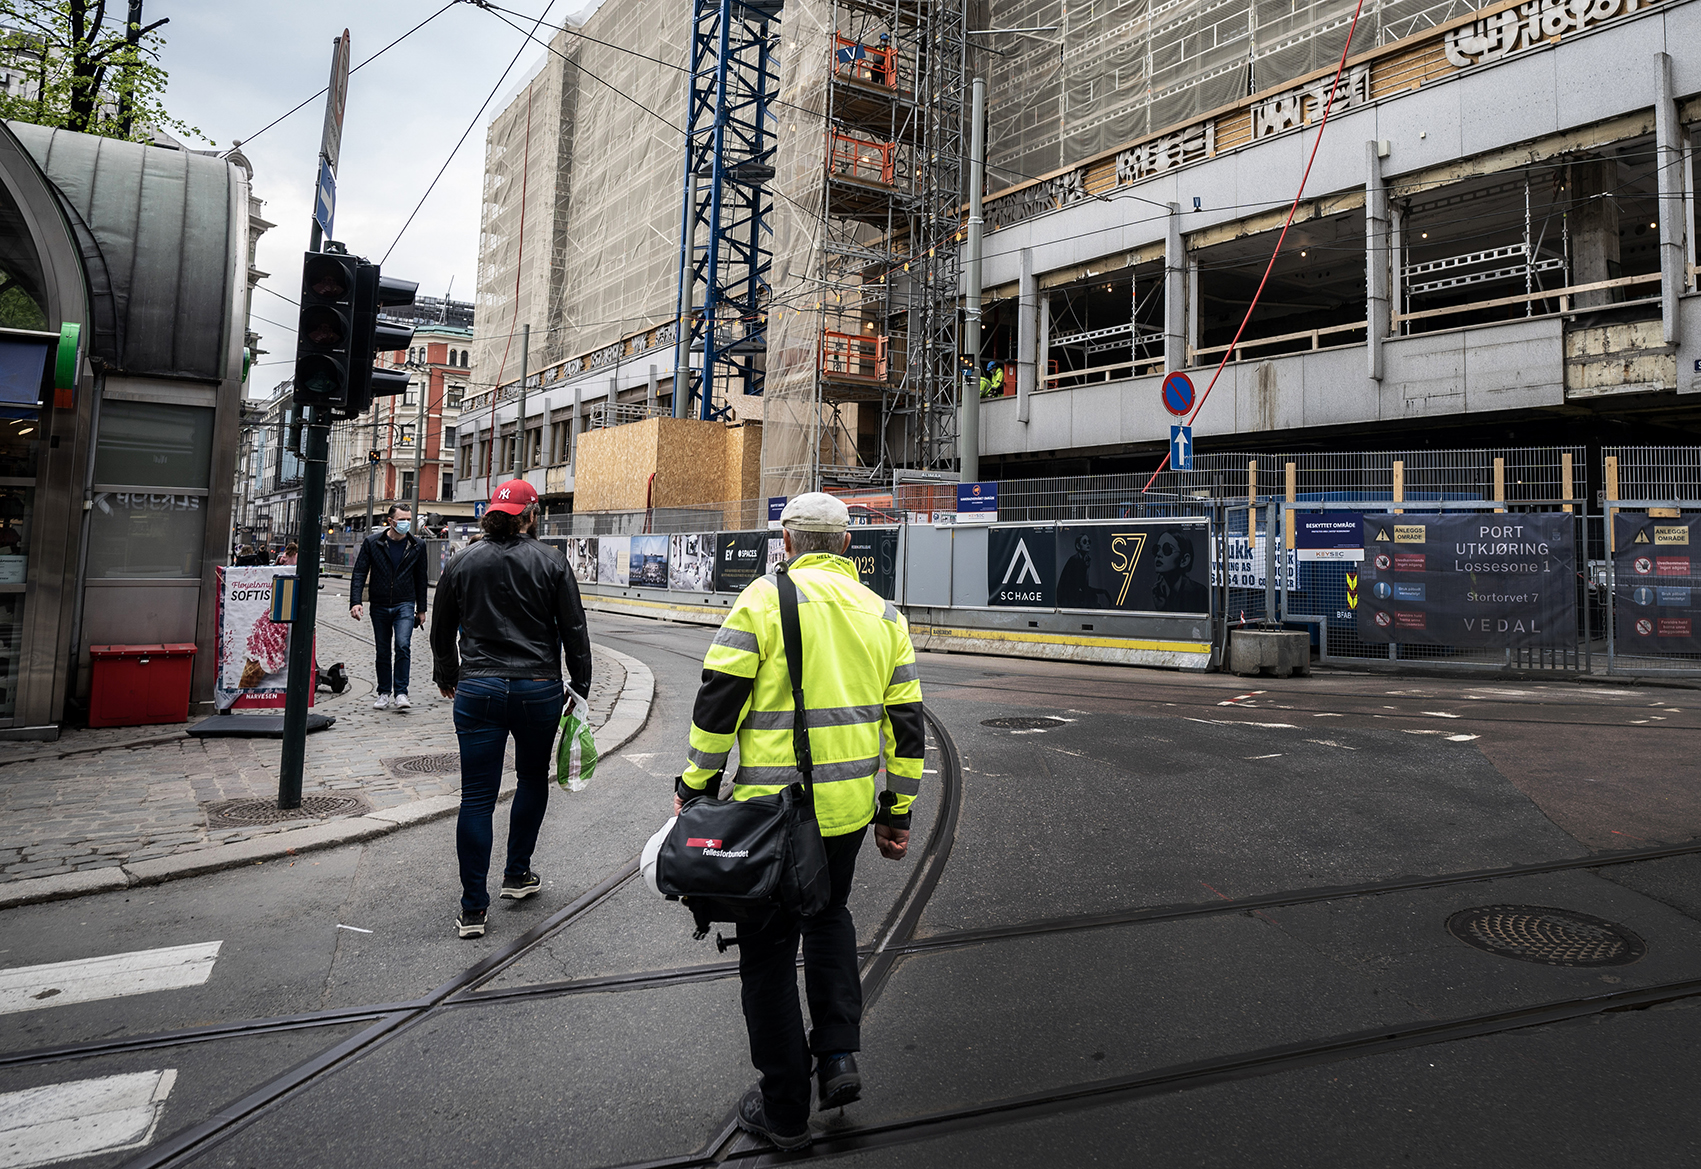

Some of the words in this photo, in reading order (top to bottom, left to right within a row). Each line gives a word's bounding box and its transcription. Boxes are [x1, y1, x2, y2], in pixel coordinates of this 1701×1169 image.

[1480, 526, 1524, 538] PORT
[1456, 543, 1549, 555] UTKJØRING
[725, 550, 734, 561] EY
[848, 556, 875, 575] 023
[1111, 533, 1148, 606] S7
[1455, 560, 1538, 572] Lossesone
[1543, 561, 1551, 572] 1
[231, 590, 271, 601] SOFTIS
[1000, 591, 1042, 602] SCHAGE
[1467, 592, 1528, 602] Stortorvet
[1532, 593, 1539, 602] 7
[1337, 611, 1352, 619] BFAB
[1464, 618, 1541, 633] VEDAL
[703, 848, 748, 857] Fellesforbundet
